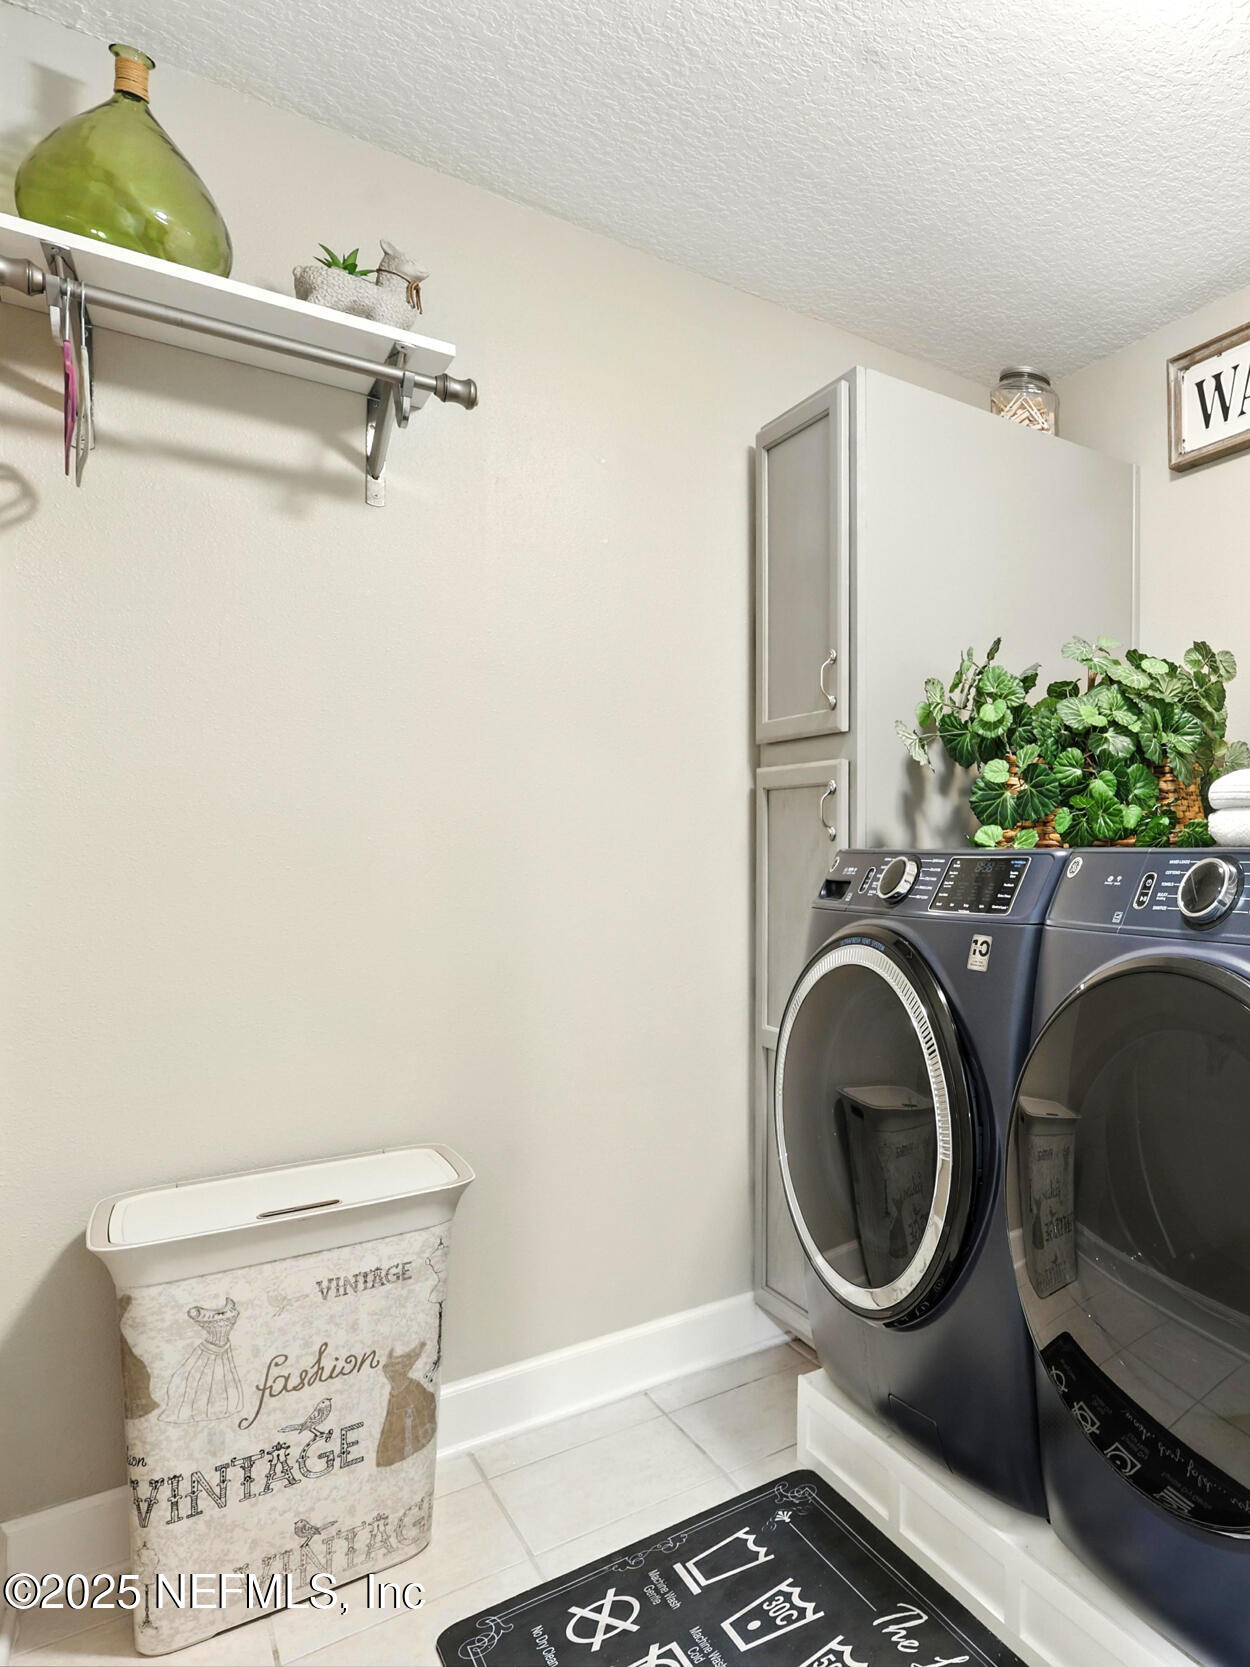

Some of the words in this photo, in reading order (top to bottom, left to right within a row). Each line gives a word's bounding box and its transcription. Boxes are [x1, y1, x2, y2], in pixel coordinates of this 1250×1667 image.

[973, 939, 990, 957] 10
[315, 1261, 413, 1300] VINTAGE
[238, 1342, 380, 1430] fashion
[127, 1450, 147, 1467] ion
[129, 1421, 365, 1529] VINTAGE
[232, 1496, 433, 1600] VINTAG
[643, 1585, 661, 1605] Gentle
[648, 1569, 669, 1593] Machine
[664, 1591, 681, 1610] Wash
[762, 1595, 798, 1626] 30C
[531, 1624, 544, 1637] No
[536, 1634, 549, 1650] Dry
[689, 1626, 712, 1653] Machine
[872, 1603, 928, 1652] The
[687, 1646, 706, 1664] Cold
